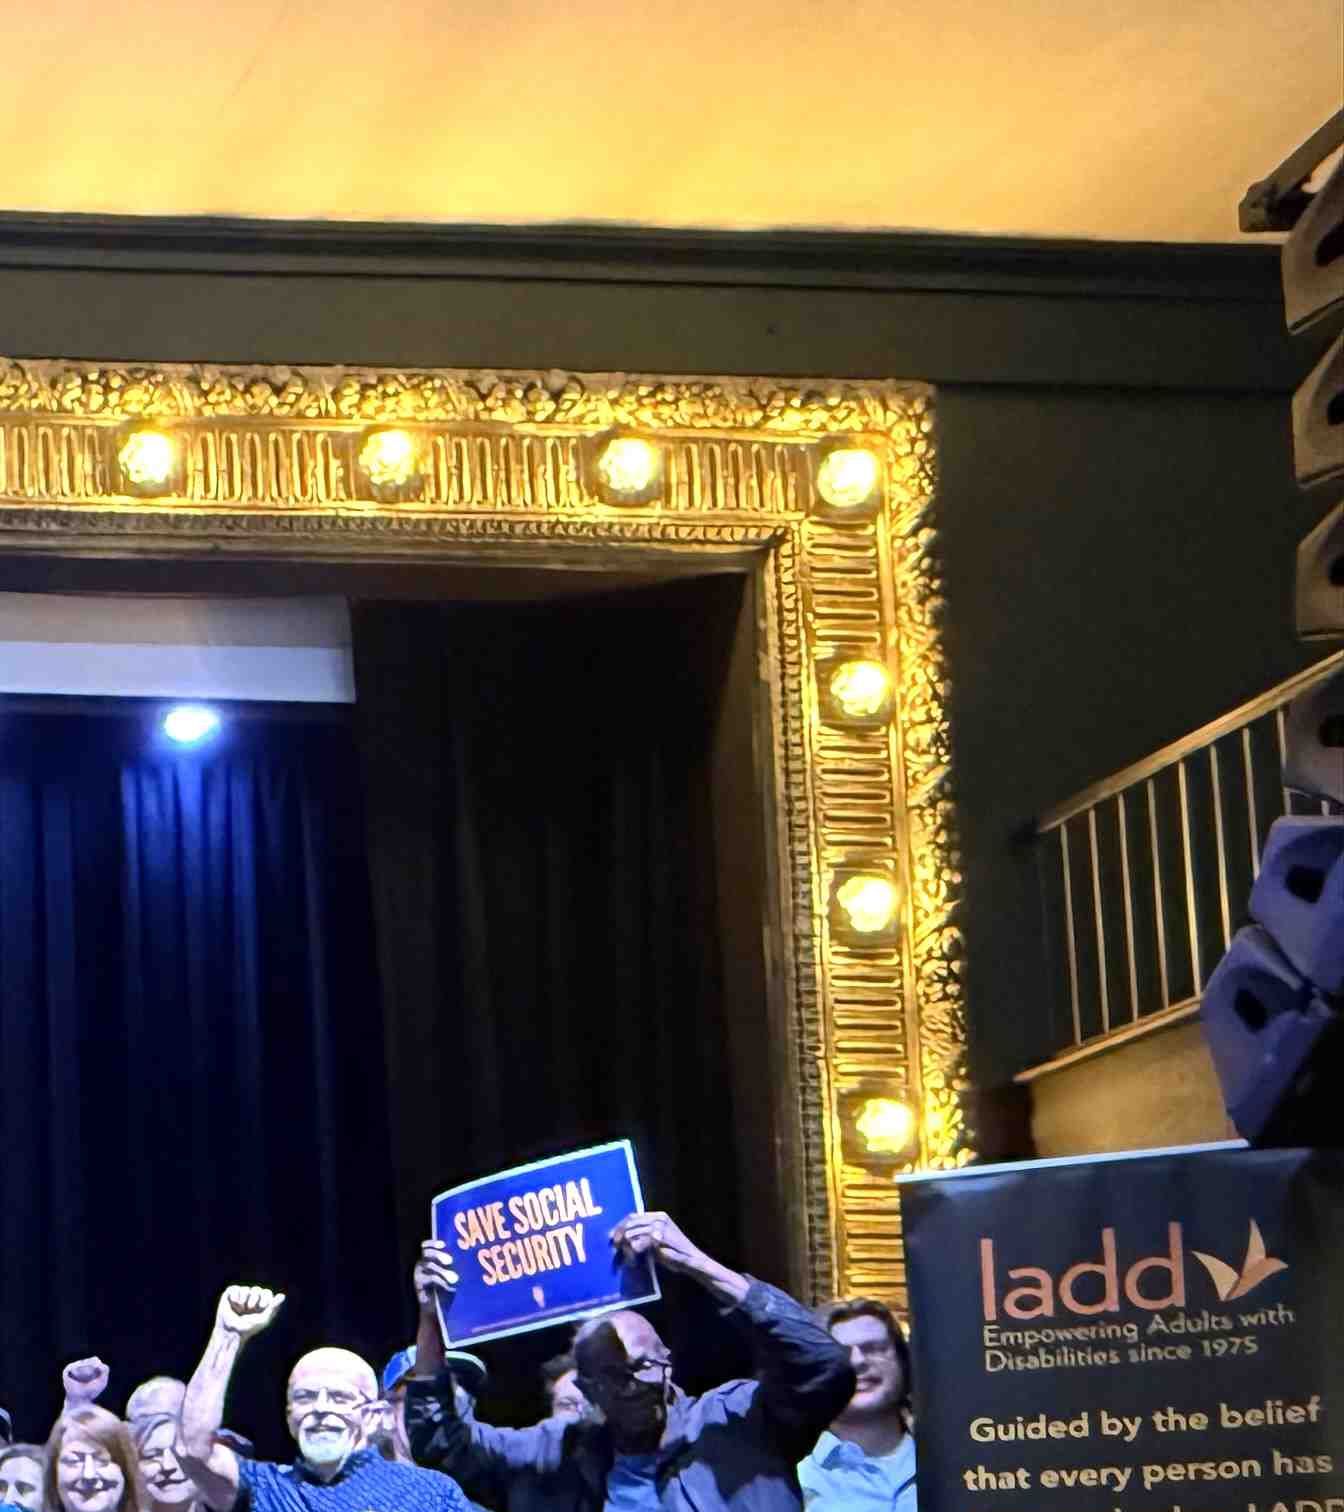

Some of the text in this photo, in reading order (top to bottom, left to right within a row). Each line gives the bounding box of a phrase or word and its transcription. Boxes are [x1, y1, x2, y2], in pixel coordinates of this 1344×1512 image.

[454, 1177, 602, 1250] SAVE SOCIAL
[478, 1223, 587, 1286] SECURITY
[979, 1221, 1187, 1321] ladd
[983, 1303, 1297, 1349] Empowering Adults with
[984, 1335, 1260, 1373] Disabilities since 1975
[969, 1394, 1326, 1443] Guided by the belief
[963, 1449, 1334, 1492] that every person has
